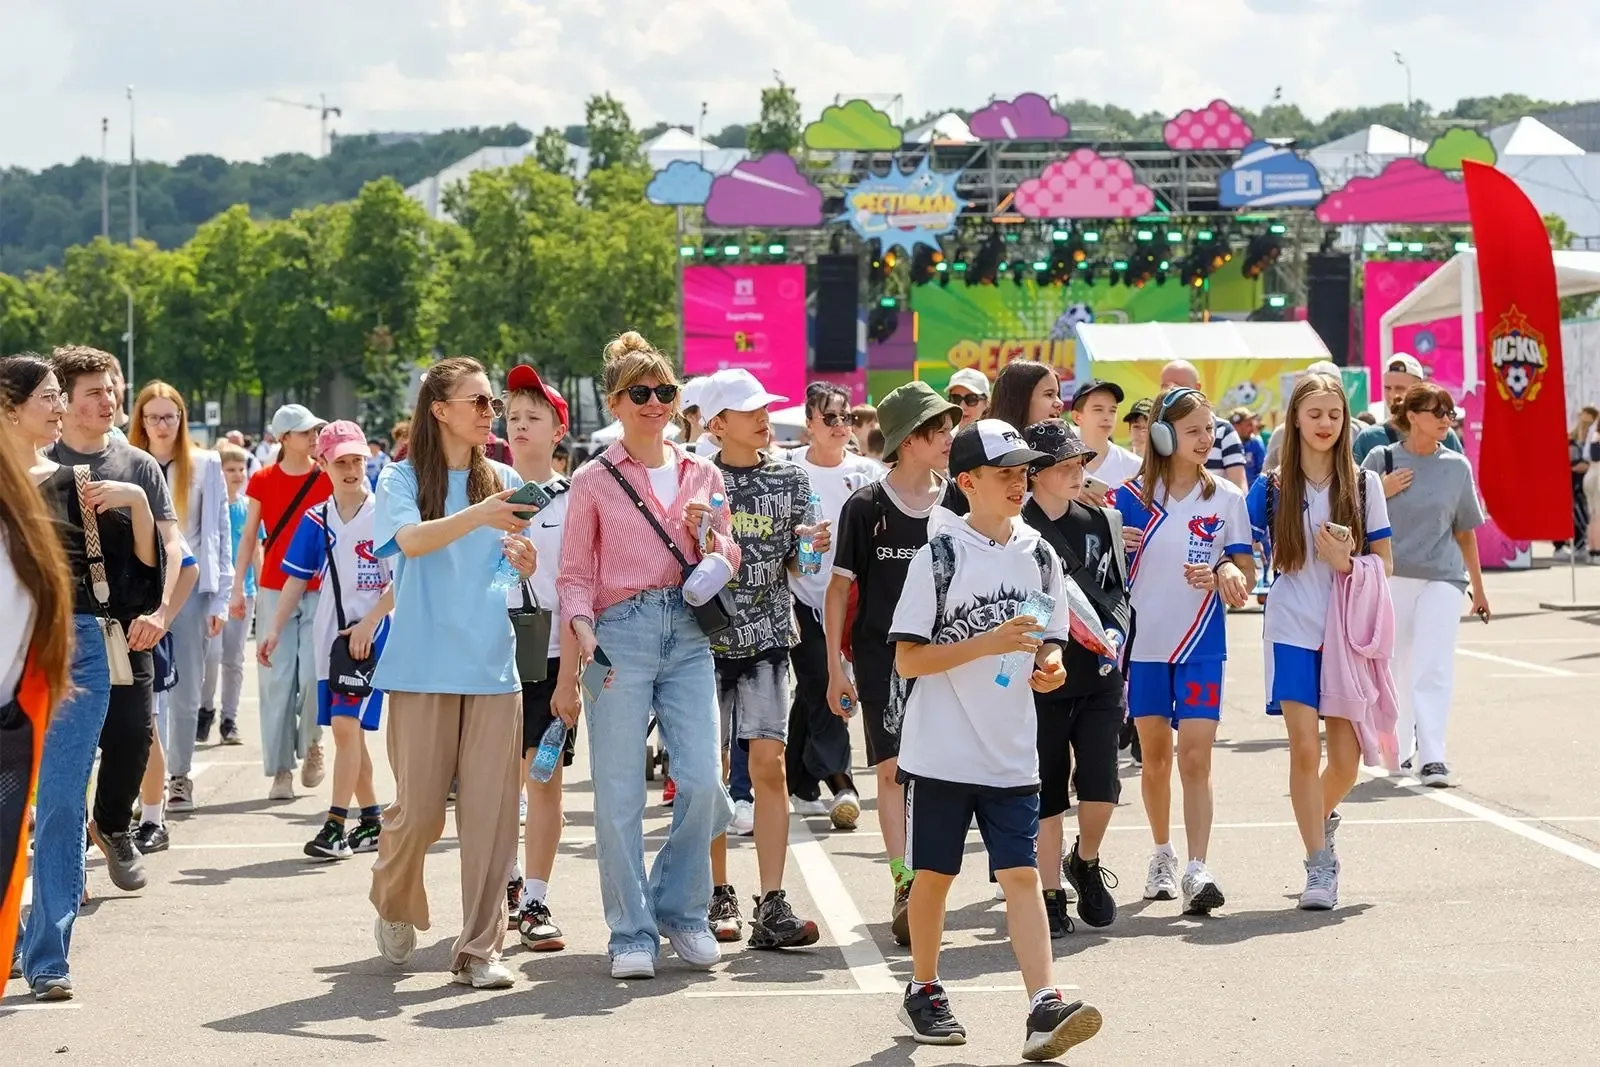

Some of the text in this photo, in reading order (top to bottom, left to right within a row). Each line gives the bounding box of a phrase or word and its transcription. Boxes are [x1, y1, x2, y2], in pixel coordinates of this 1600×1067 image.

[1492, 335, 1544, 367] ЦСКА
[876, 546, 920, 561] gsussi
[338, 674, 364, 687] PUMA
